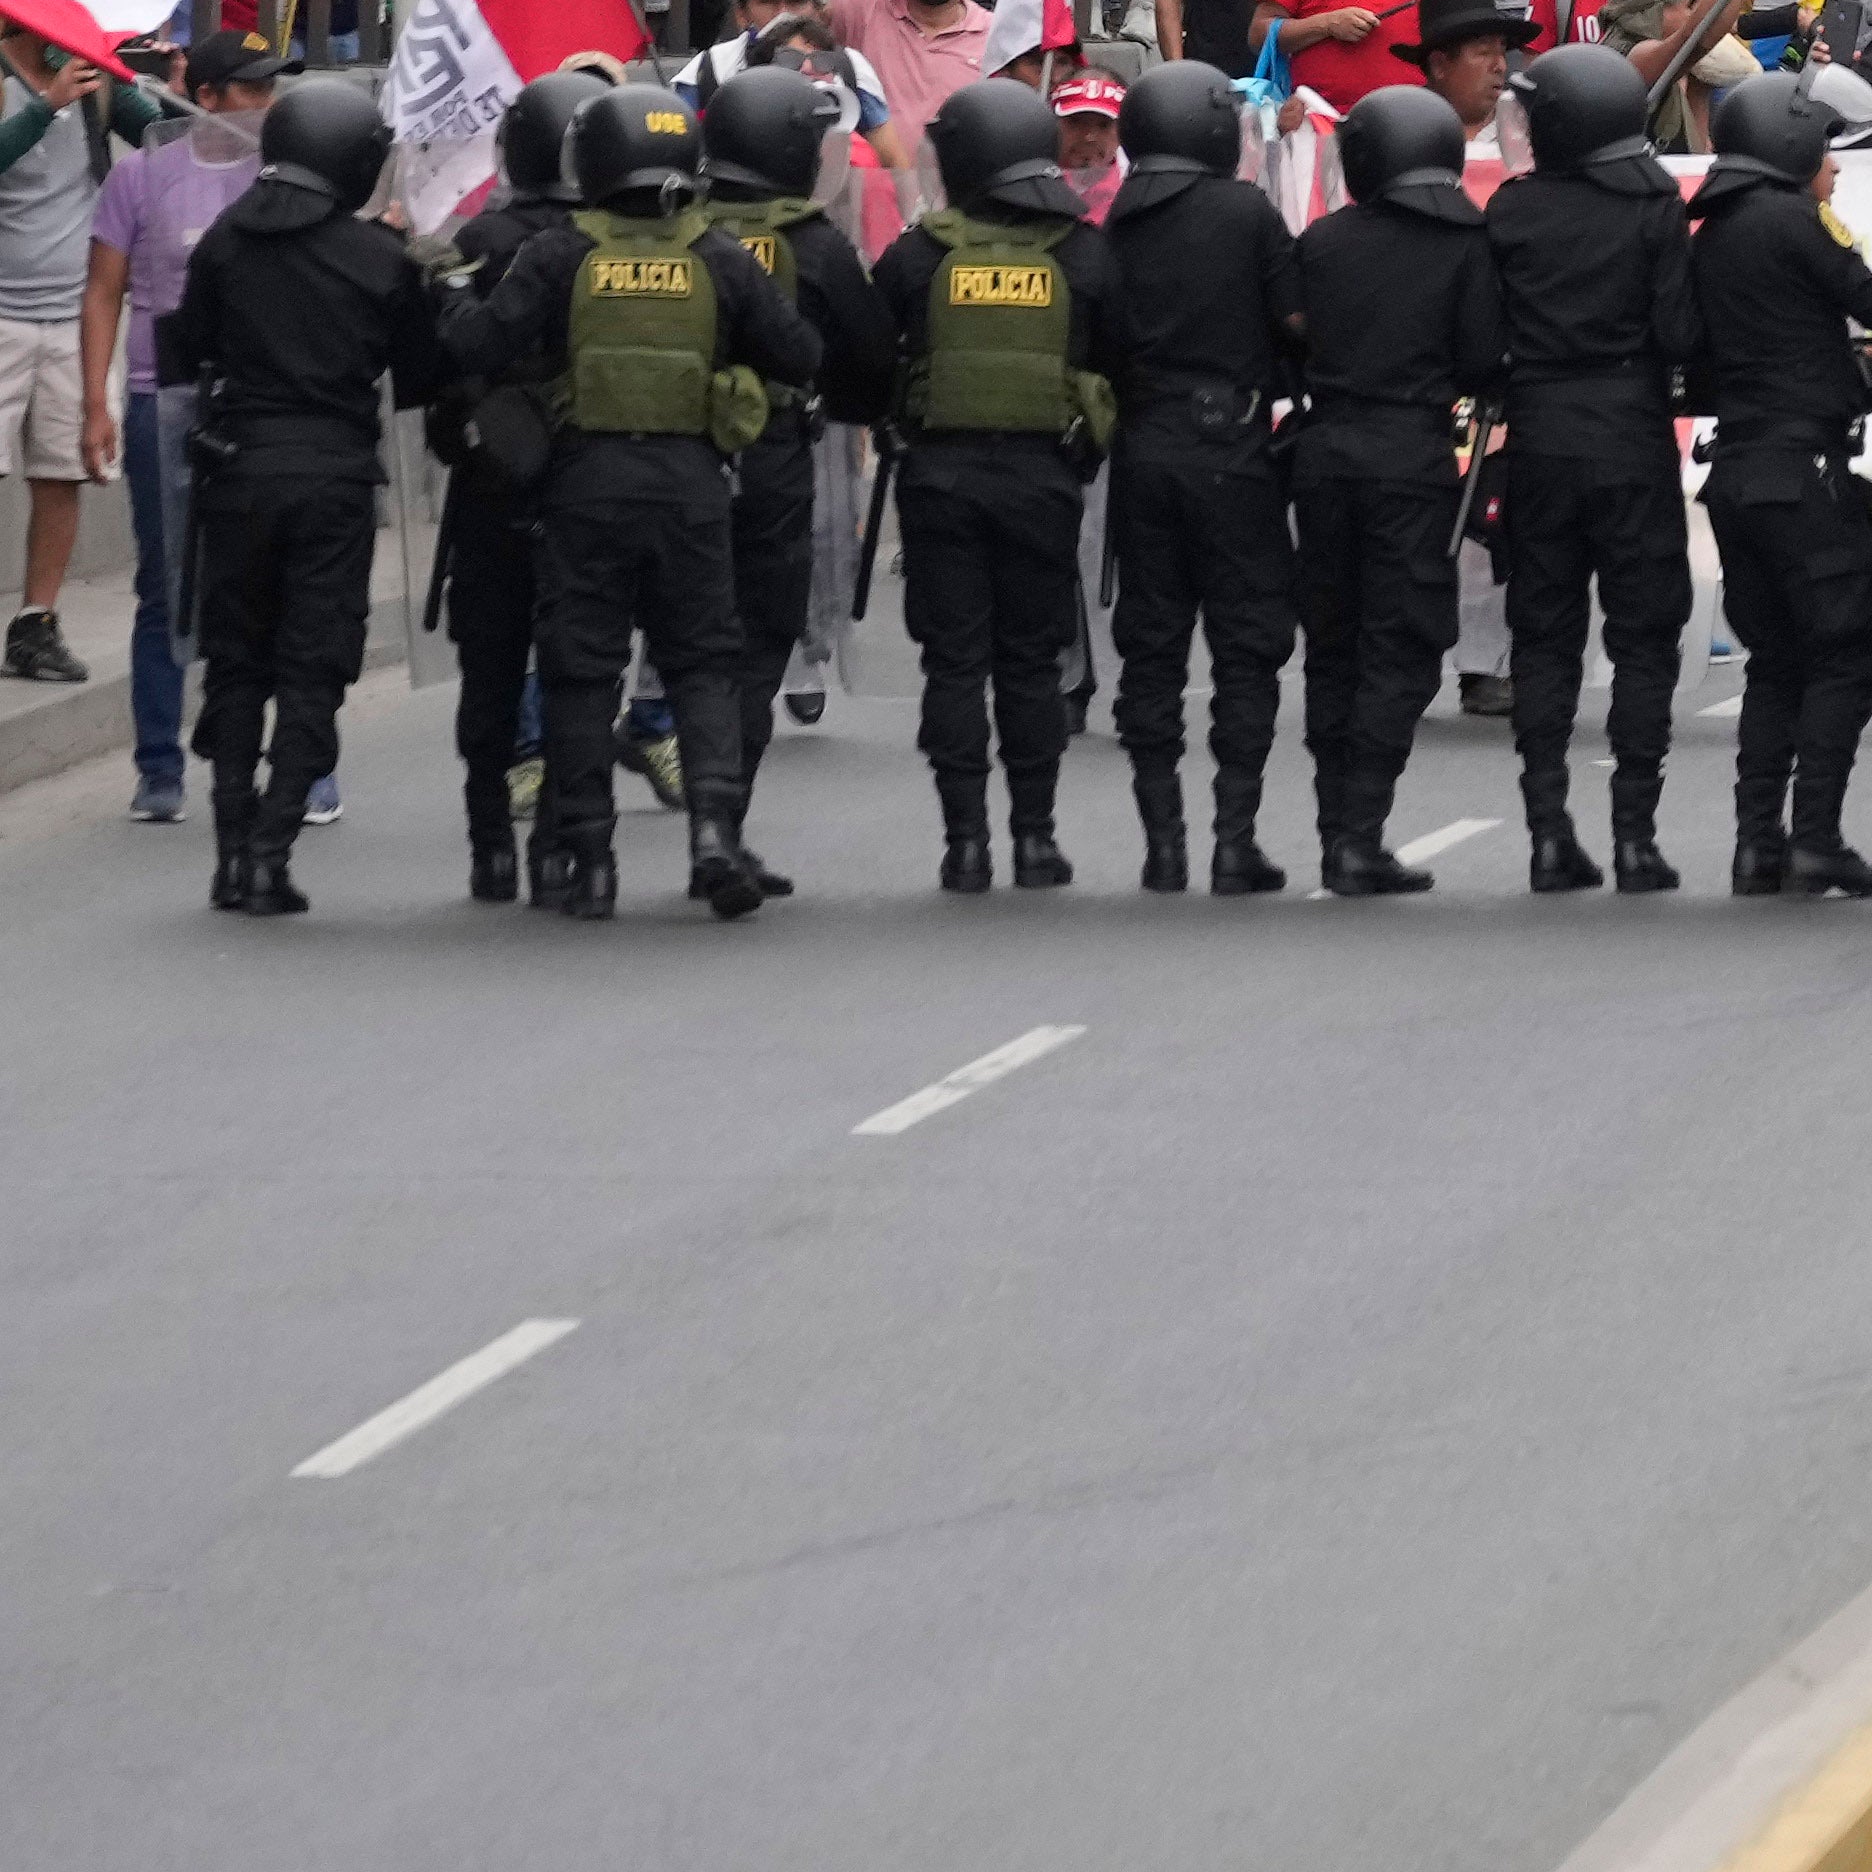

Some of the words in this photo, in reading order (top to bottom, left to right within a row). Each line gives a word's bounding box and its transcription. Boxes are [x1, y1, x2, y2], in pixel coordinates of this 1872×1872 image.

[1576, 14, 1600, 43] 10
[593, 264, 687, 293] POLICIA
[954, 271, 1048, 301] POLICIA
